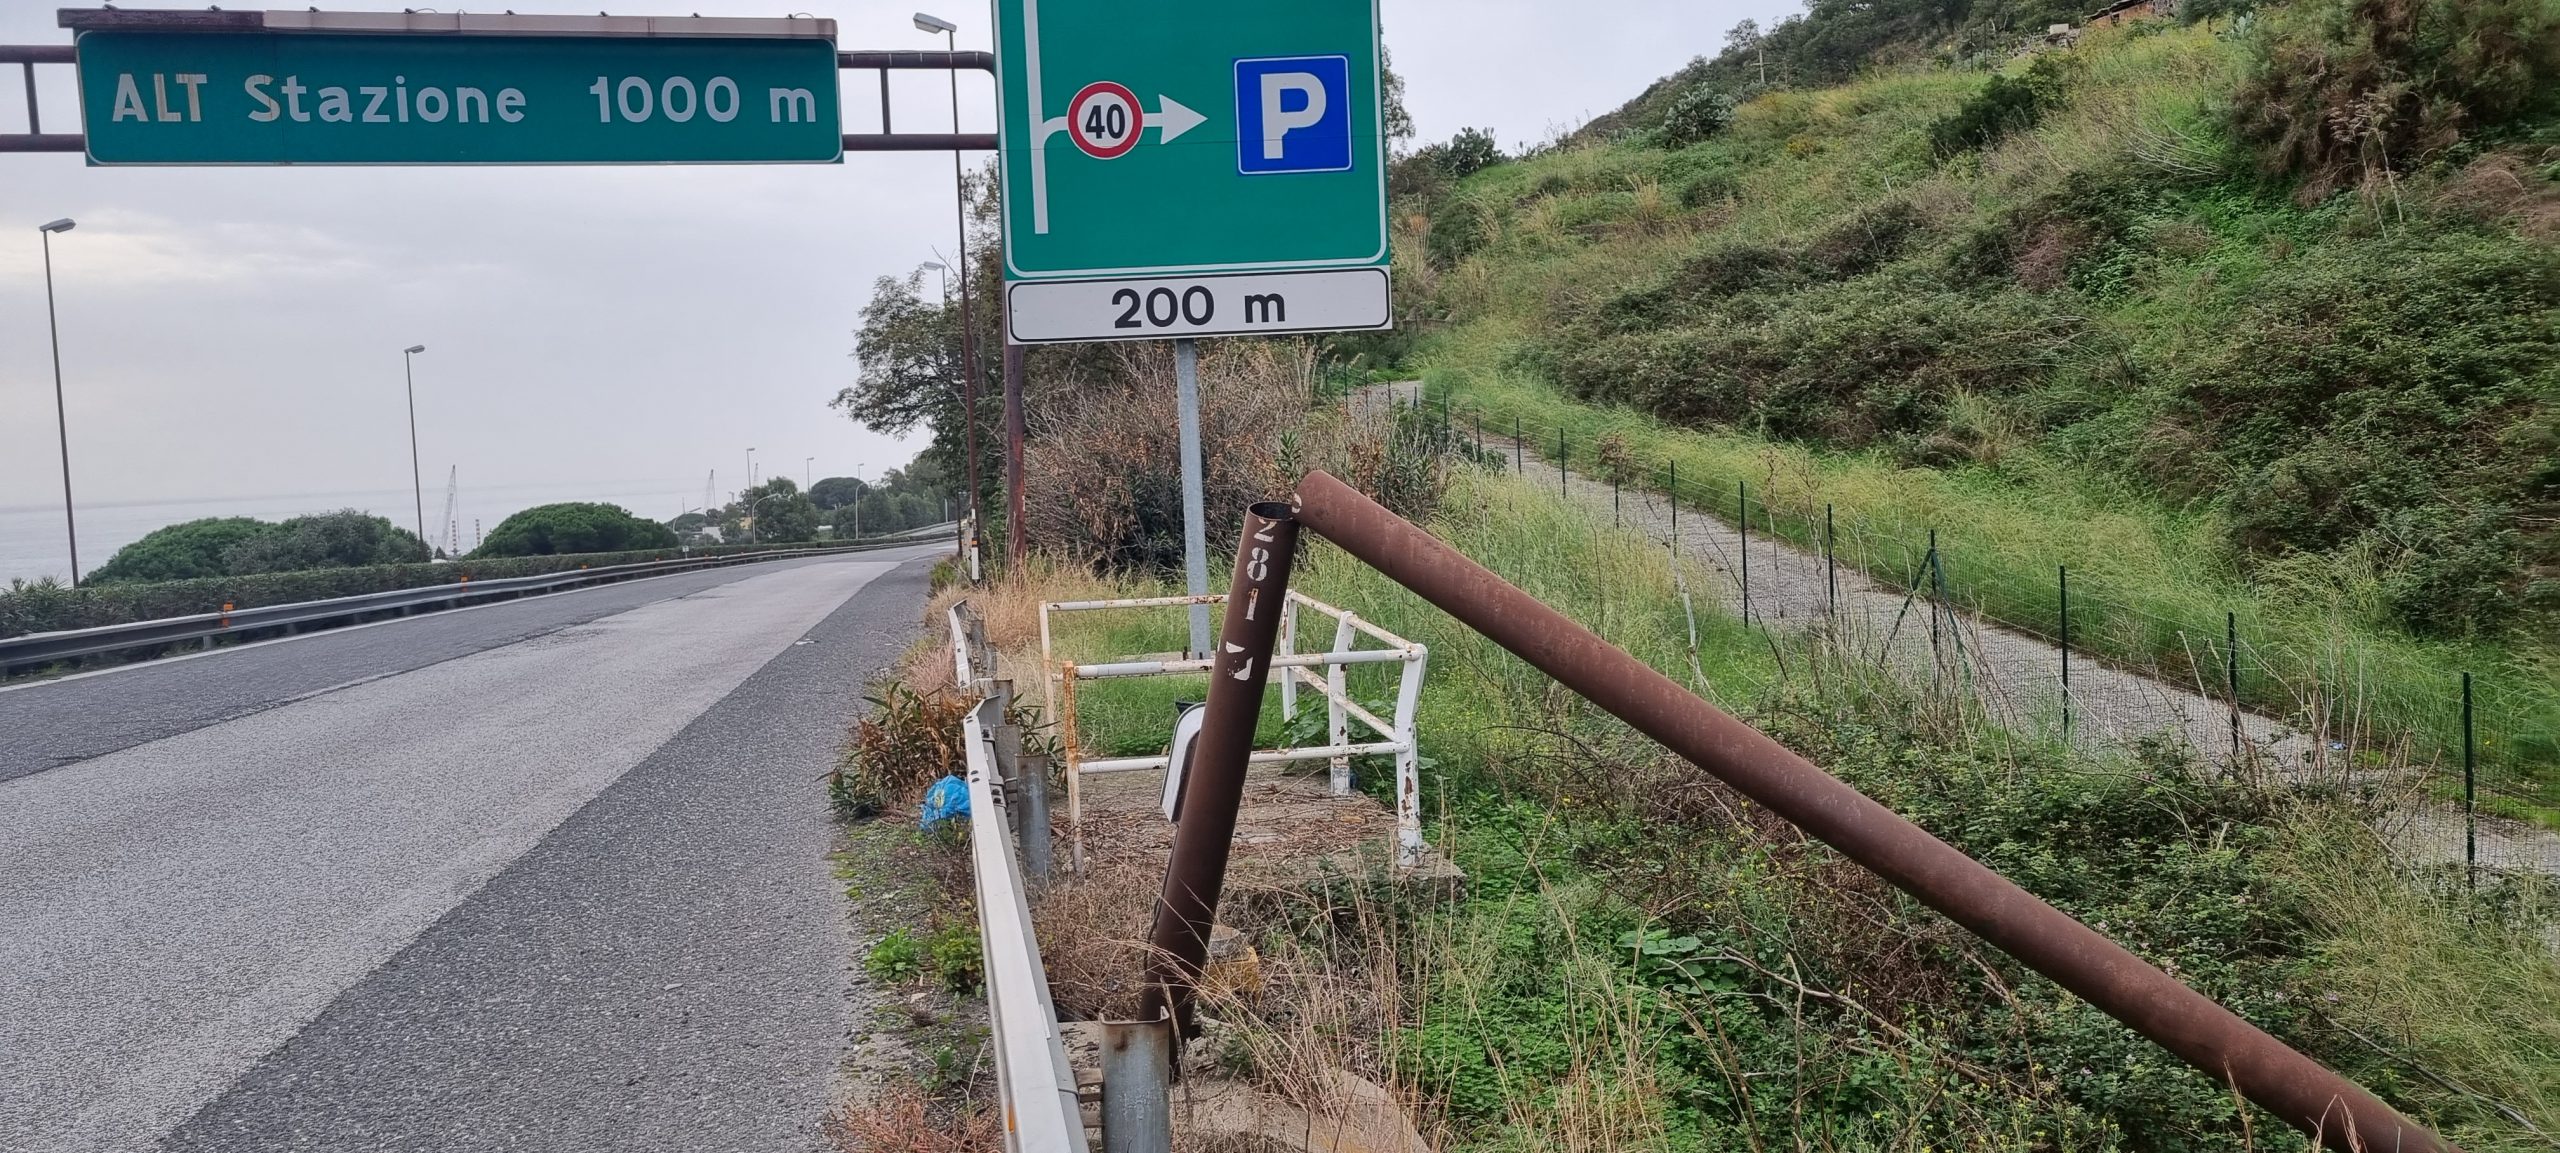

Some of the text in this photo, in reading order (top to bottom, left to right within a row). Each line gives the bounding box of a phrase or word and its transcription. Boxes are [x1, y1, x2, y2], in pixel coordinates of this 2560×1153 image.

[111, 73, 817, 123] ALT Stazione 1000 m
[1085, 104, 1125, 139] 40
[1261, 72, 1326, 159] P
[1111, 285, 1286, 329] 200 m
